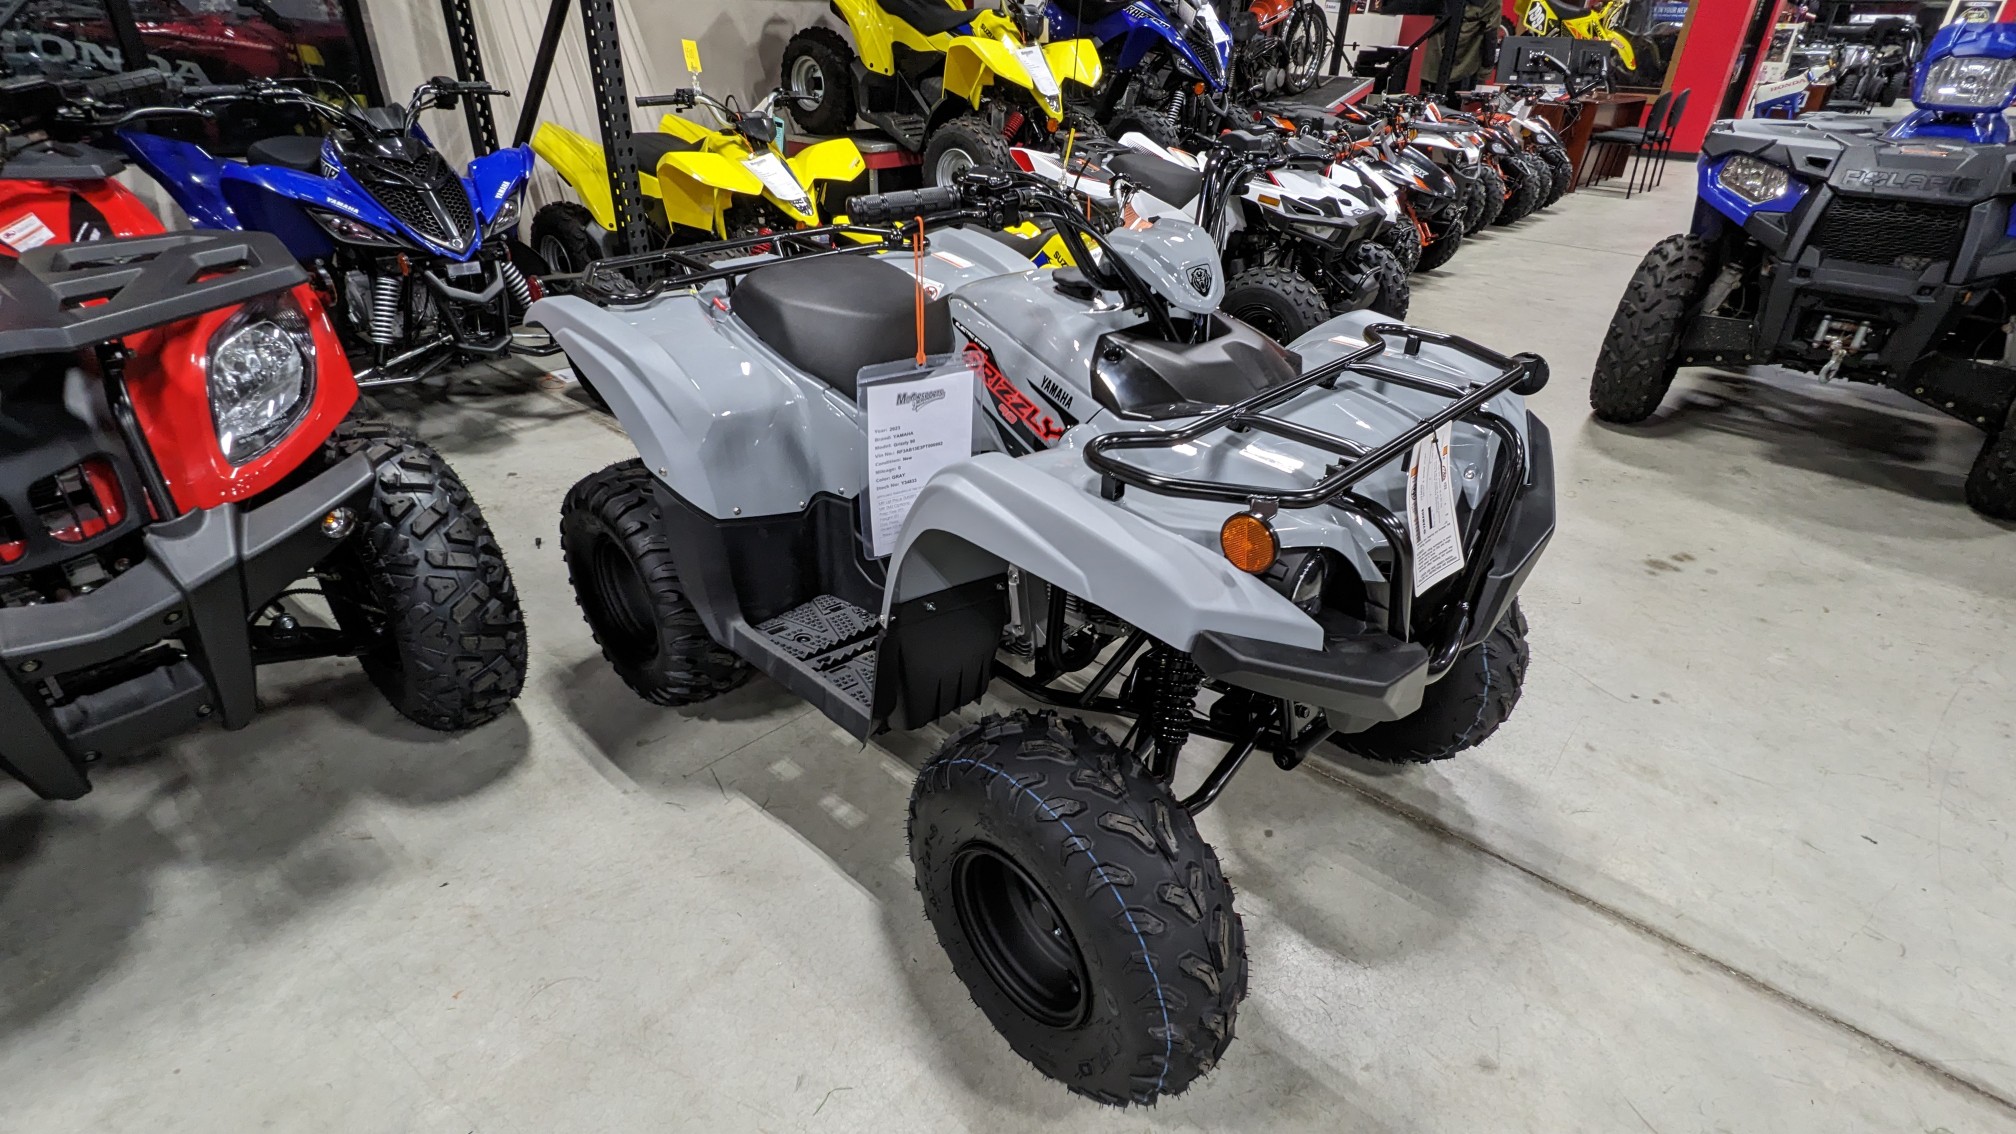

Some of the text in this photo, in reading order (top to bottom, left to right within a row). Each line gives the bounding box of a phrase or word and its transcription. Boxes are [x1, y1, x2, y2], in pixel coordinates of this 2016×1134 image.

[981, 23, 997, 41] SUZU
[1770, 78, 1807, 93] HONDA
[494, 180, 511, 199] YAMAHA
[326, 196, 360, 214] YAMAHA
[1040, 374, 1074, 410] YAMAHA
[998, 403, 1018, 425] 90
[893, 431, 914, 439] YAMAHA
